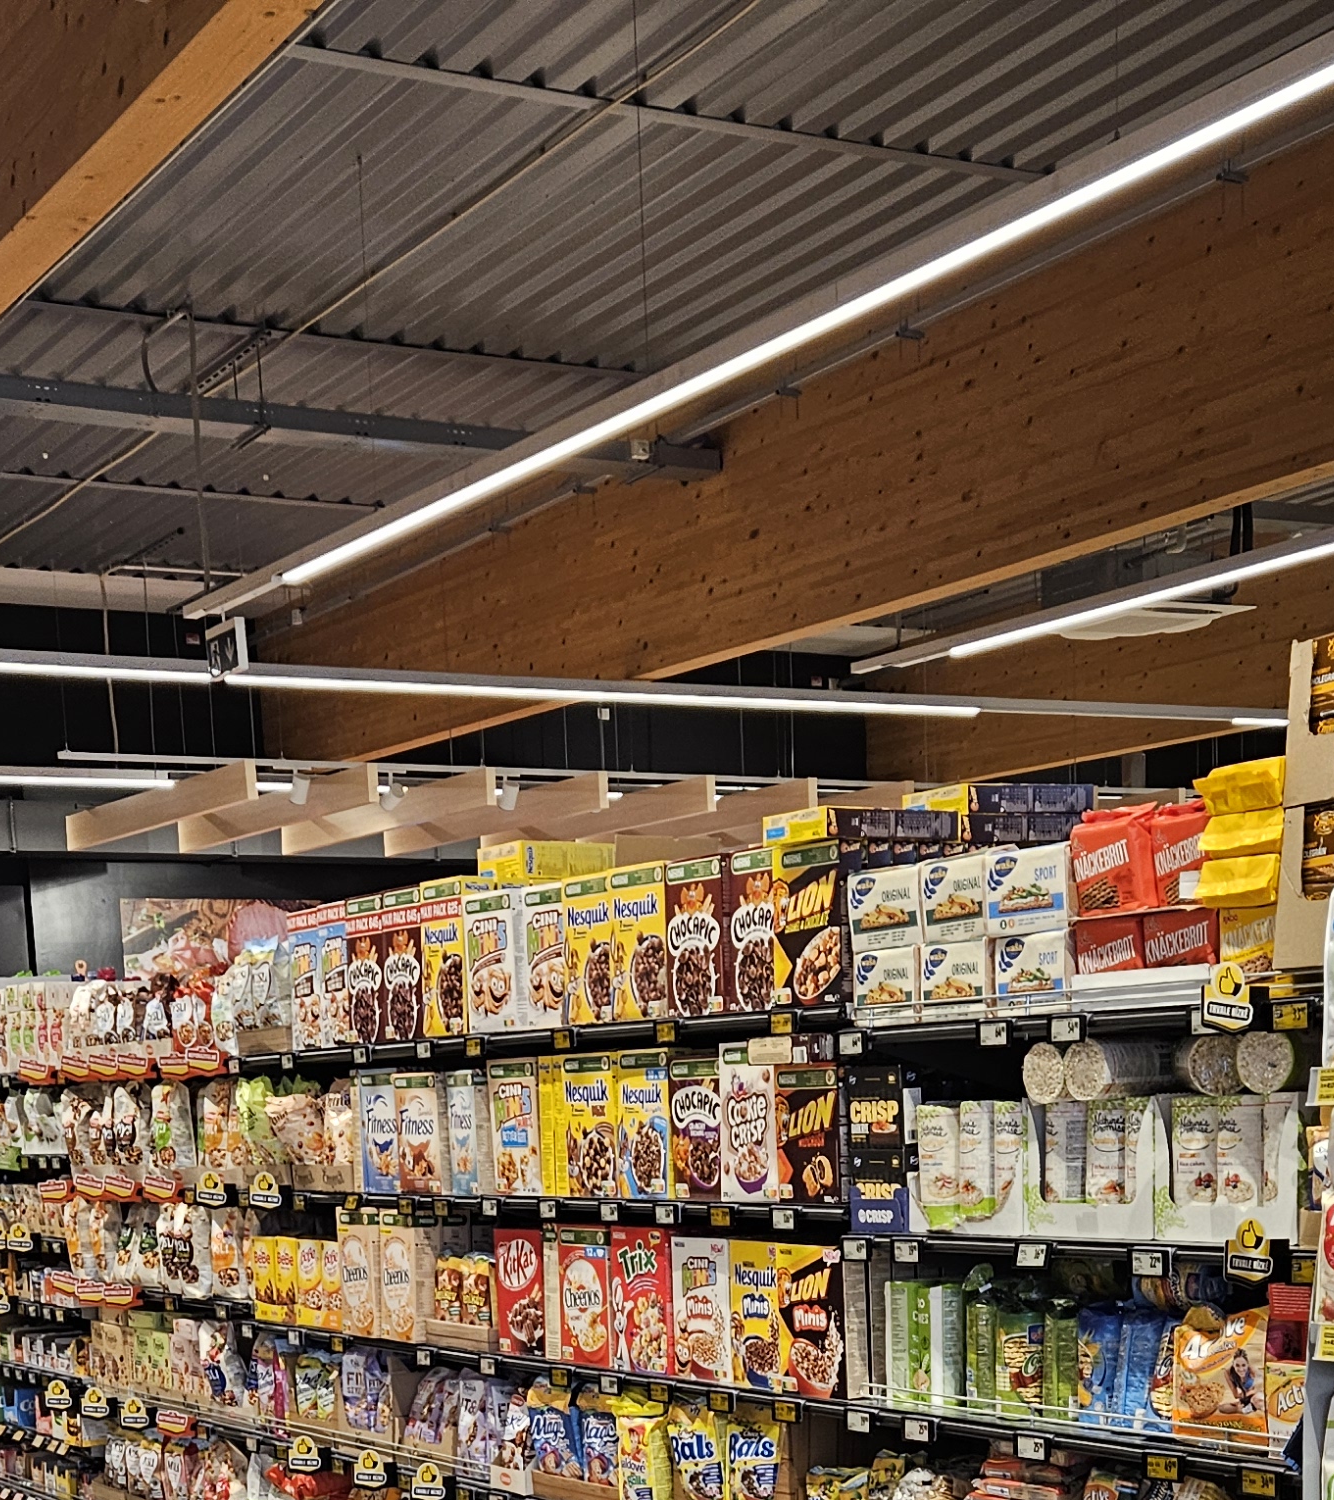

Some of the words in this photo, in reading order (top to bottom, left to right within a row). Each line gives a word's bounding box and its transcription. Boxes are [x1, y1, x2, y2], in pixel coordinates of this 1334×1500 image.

[952, 876, 982, 892] ORIGINAL
[1034, 865, 1058, 881] SPORT
[613, 895, 657, 920] Nesquik
[788, 870, 837, 922] LION
[881, 887, 911, 902] ORIGINAL
[567, 902, 609, 928] Nesquik
[670, 918, 716, 950] CHOCAPIC
[1145, 920, 1209, 964] KNÄCKEBROT
[565, 1080, 609, 1107] Nesquik
[622, 1084, 662, 1109] Nesquik
[399, 1109, 434, 1135] Fitness
[789, 1091, 836, 1138] LION
[849, 1101, 900, 1123] CRISP
[865, 1208, 894, 1225] CRISP
[501, 1240, 534, 1283] KitKat
[618, 1239, 657, 1281] Trix
[735, 1264, 777, 1291] Nesquik
